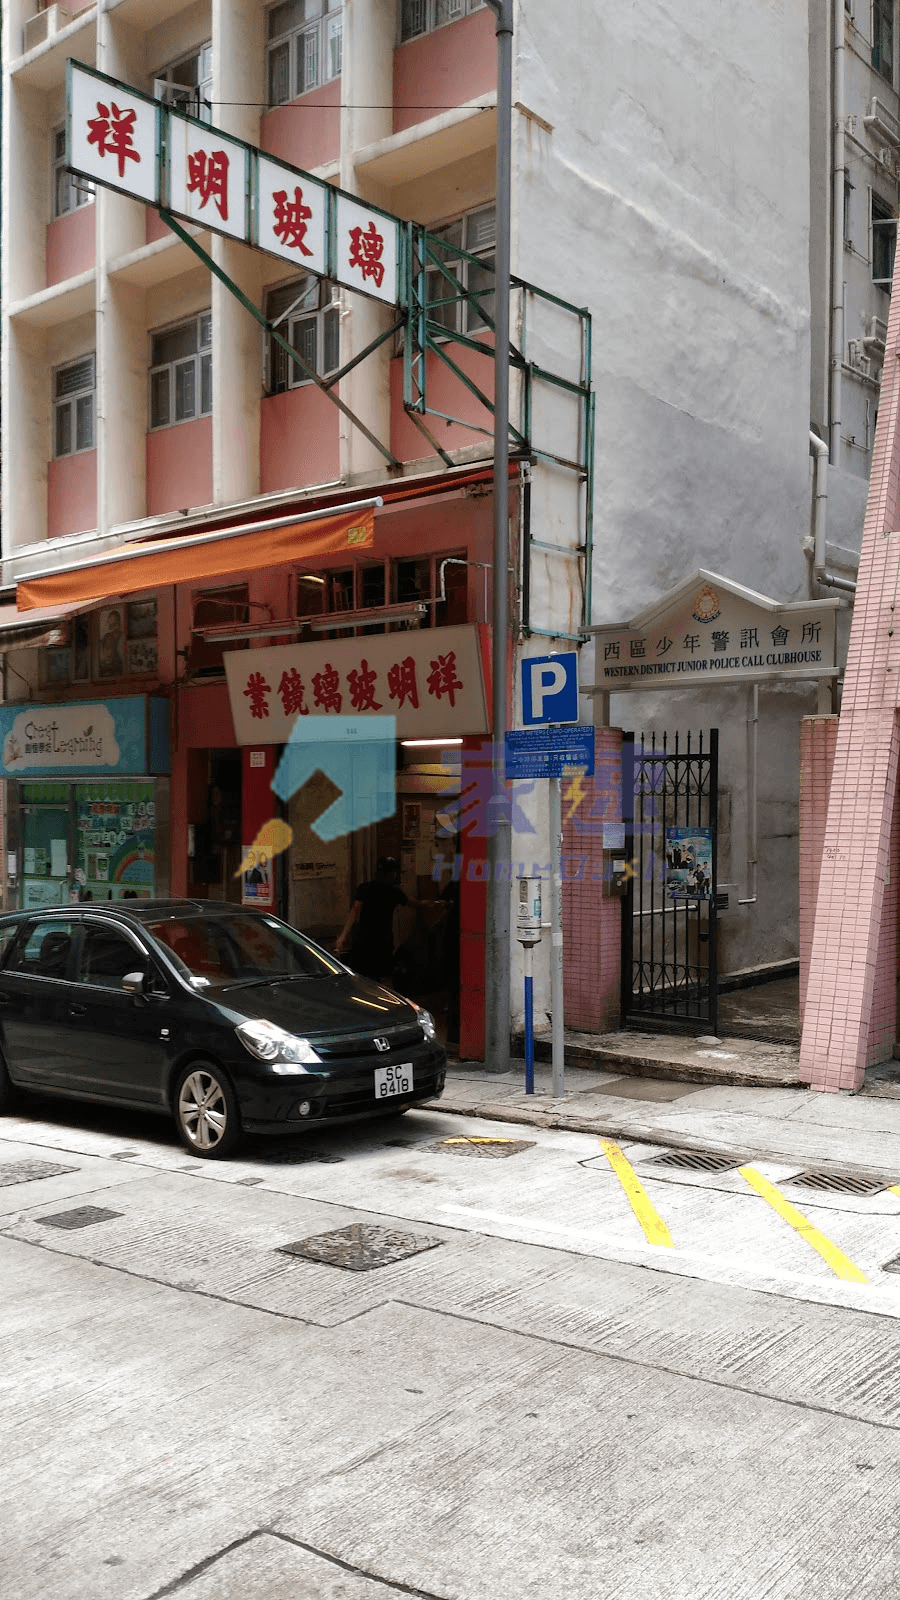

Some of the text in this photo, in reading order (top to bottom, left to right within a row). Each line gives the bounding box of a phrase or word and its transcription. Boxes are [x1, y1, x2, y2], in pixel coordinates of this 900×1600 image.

[87, 101, 387, 288] 祥明玻璃
[603, 621, 822, 661] 西區少年警訊會所
[603, 650, 822, 677] WESTERN DISTRICT JUNIOR POLICE CALL CLUBHOUSE
[530, 661, 567, 718] P
[380, 1078, 409, 1097] 8418
[386, 1065, 403, 1081] SC
